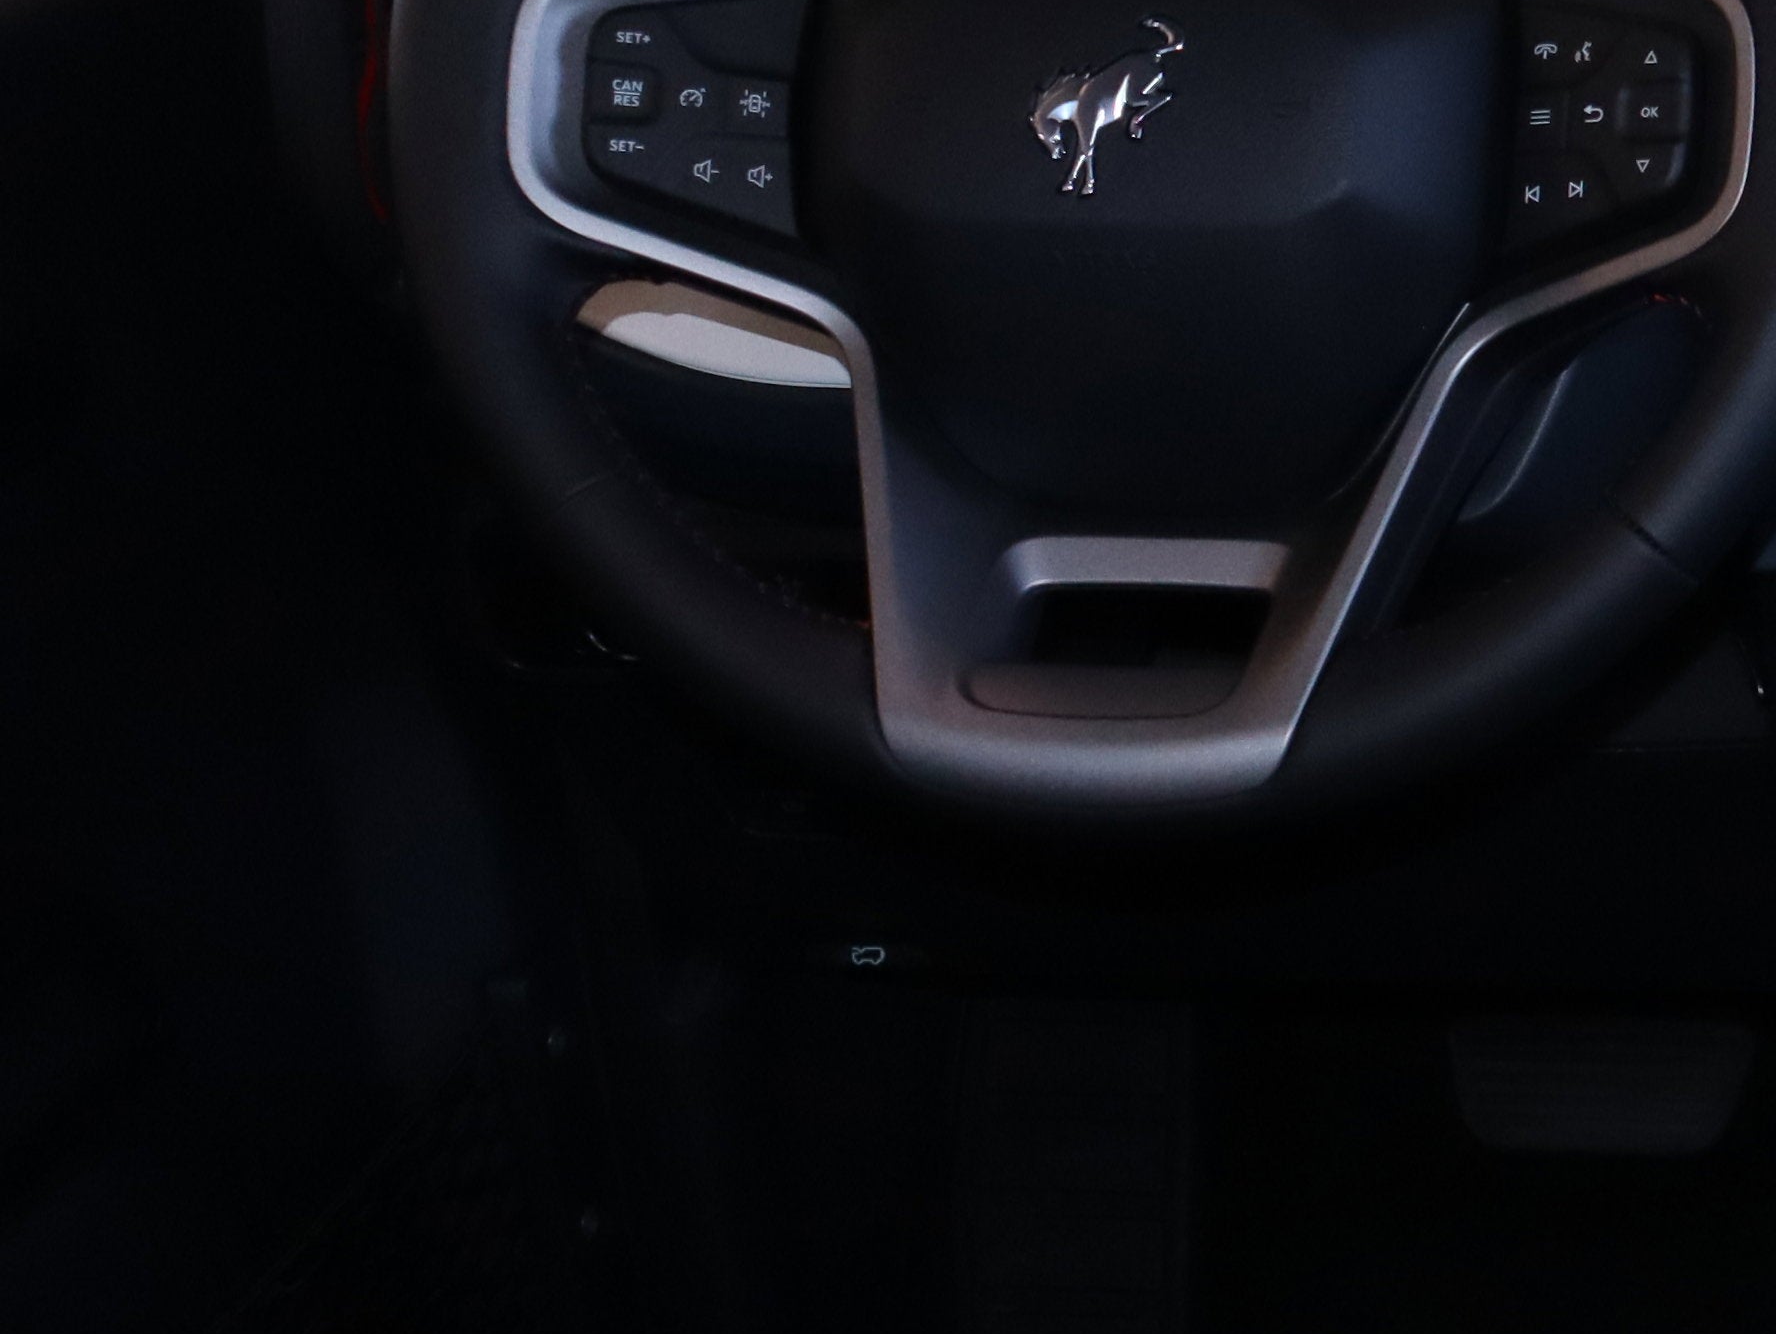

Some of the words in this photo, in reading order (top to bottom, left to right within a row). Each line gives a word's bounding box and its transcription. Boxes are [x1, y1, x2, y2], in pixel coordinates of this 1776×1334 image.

[616, 32, 651, 44] SET+
[612, 79, 643, 92] CAN
[613, 95, 640, 107] RES
[1640, 106, 1658, 119] OK
